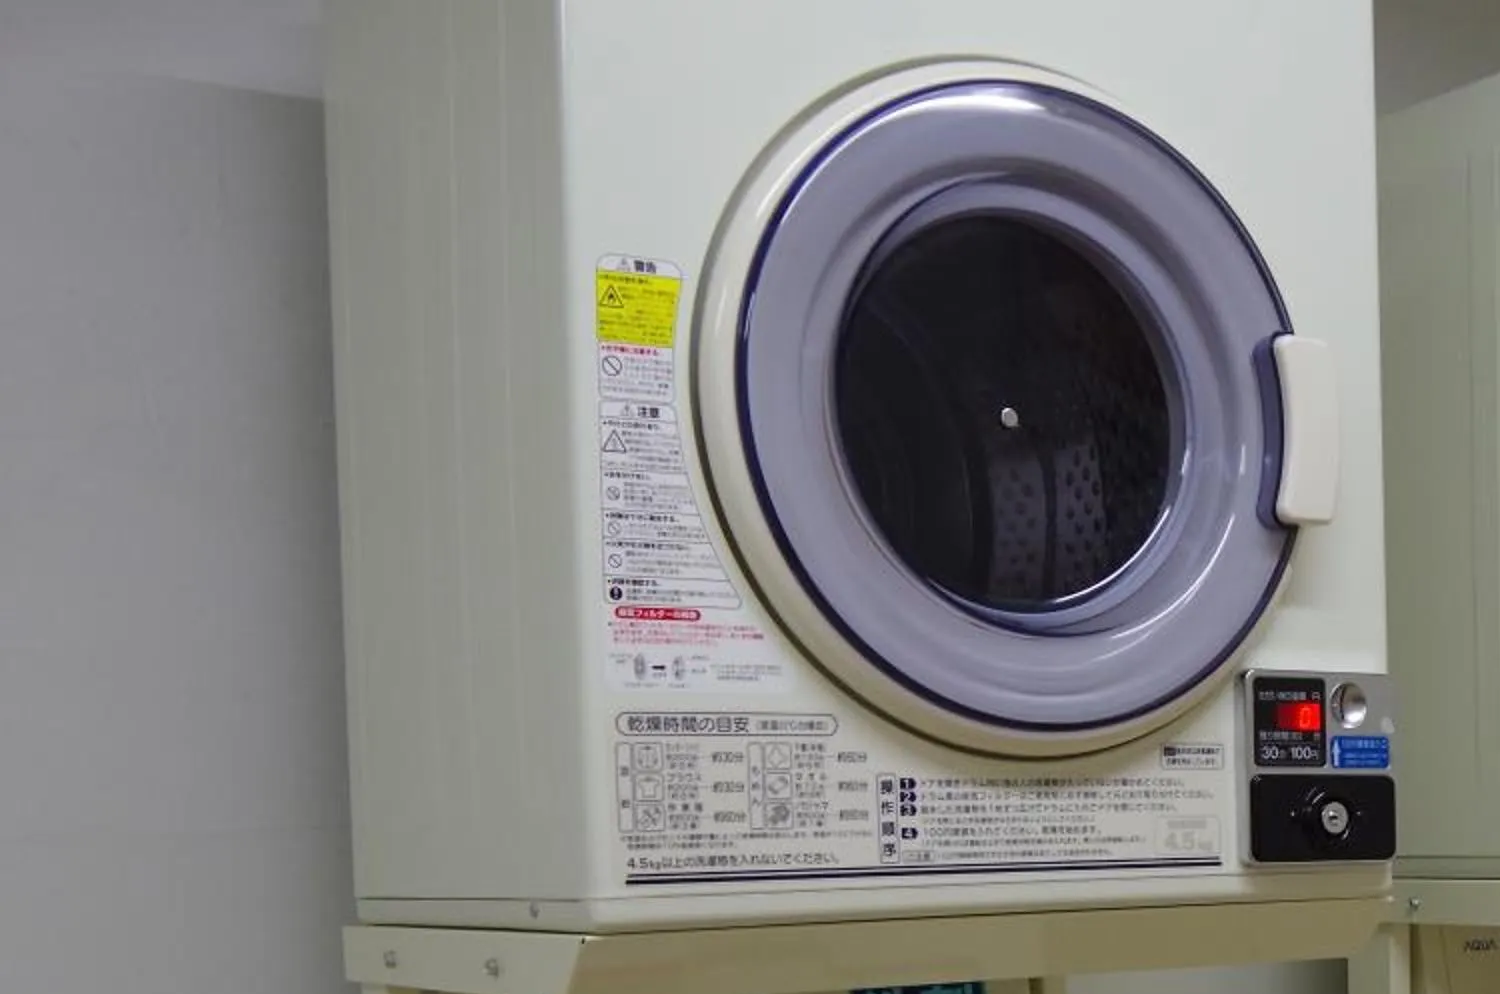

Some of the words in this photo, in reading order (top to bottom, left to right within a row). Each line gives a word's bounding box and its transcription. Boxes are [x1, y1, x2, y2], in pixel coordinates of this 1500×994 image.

[627, 716, 749, 733] 乾燥時間の目安
[1300, 707, 1311, 726] 0
